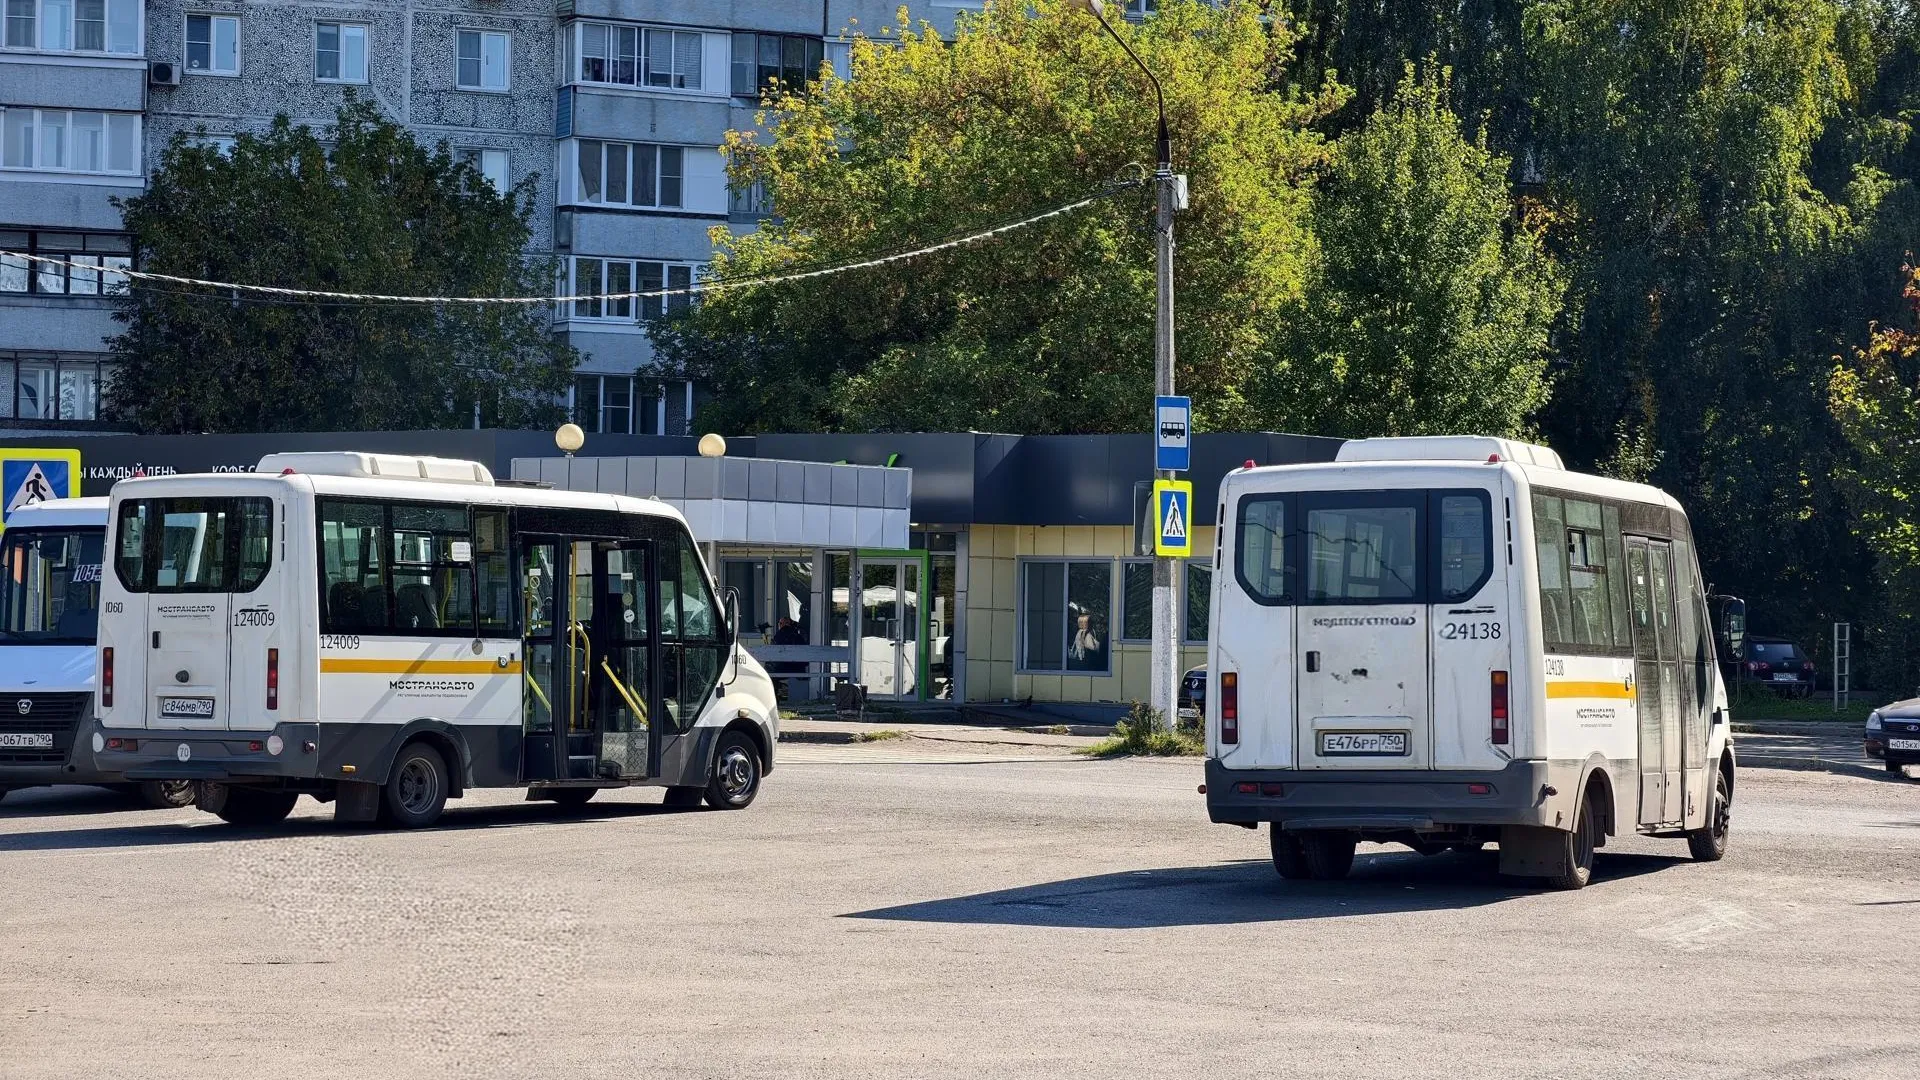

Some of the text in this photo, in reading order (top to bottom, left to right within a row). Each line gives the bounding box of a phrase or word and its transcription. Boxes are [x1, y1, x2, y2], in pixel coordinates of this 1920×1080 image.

[76, 565, 95, 581] 105
[105, 602, 123, 613] 1060
[234, 612, 275, 627] 124009
[320, 635, 360, 650] 124009
[1545, 658, 1564, 676] 124138
[389, 681, 475, 691] МОСТРАНСАВТО
[1380, 735, 1401, 746] 750
[179, 747, 189, 757] 70
